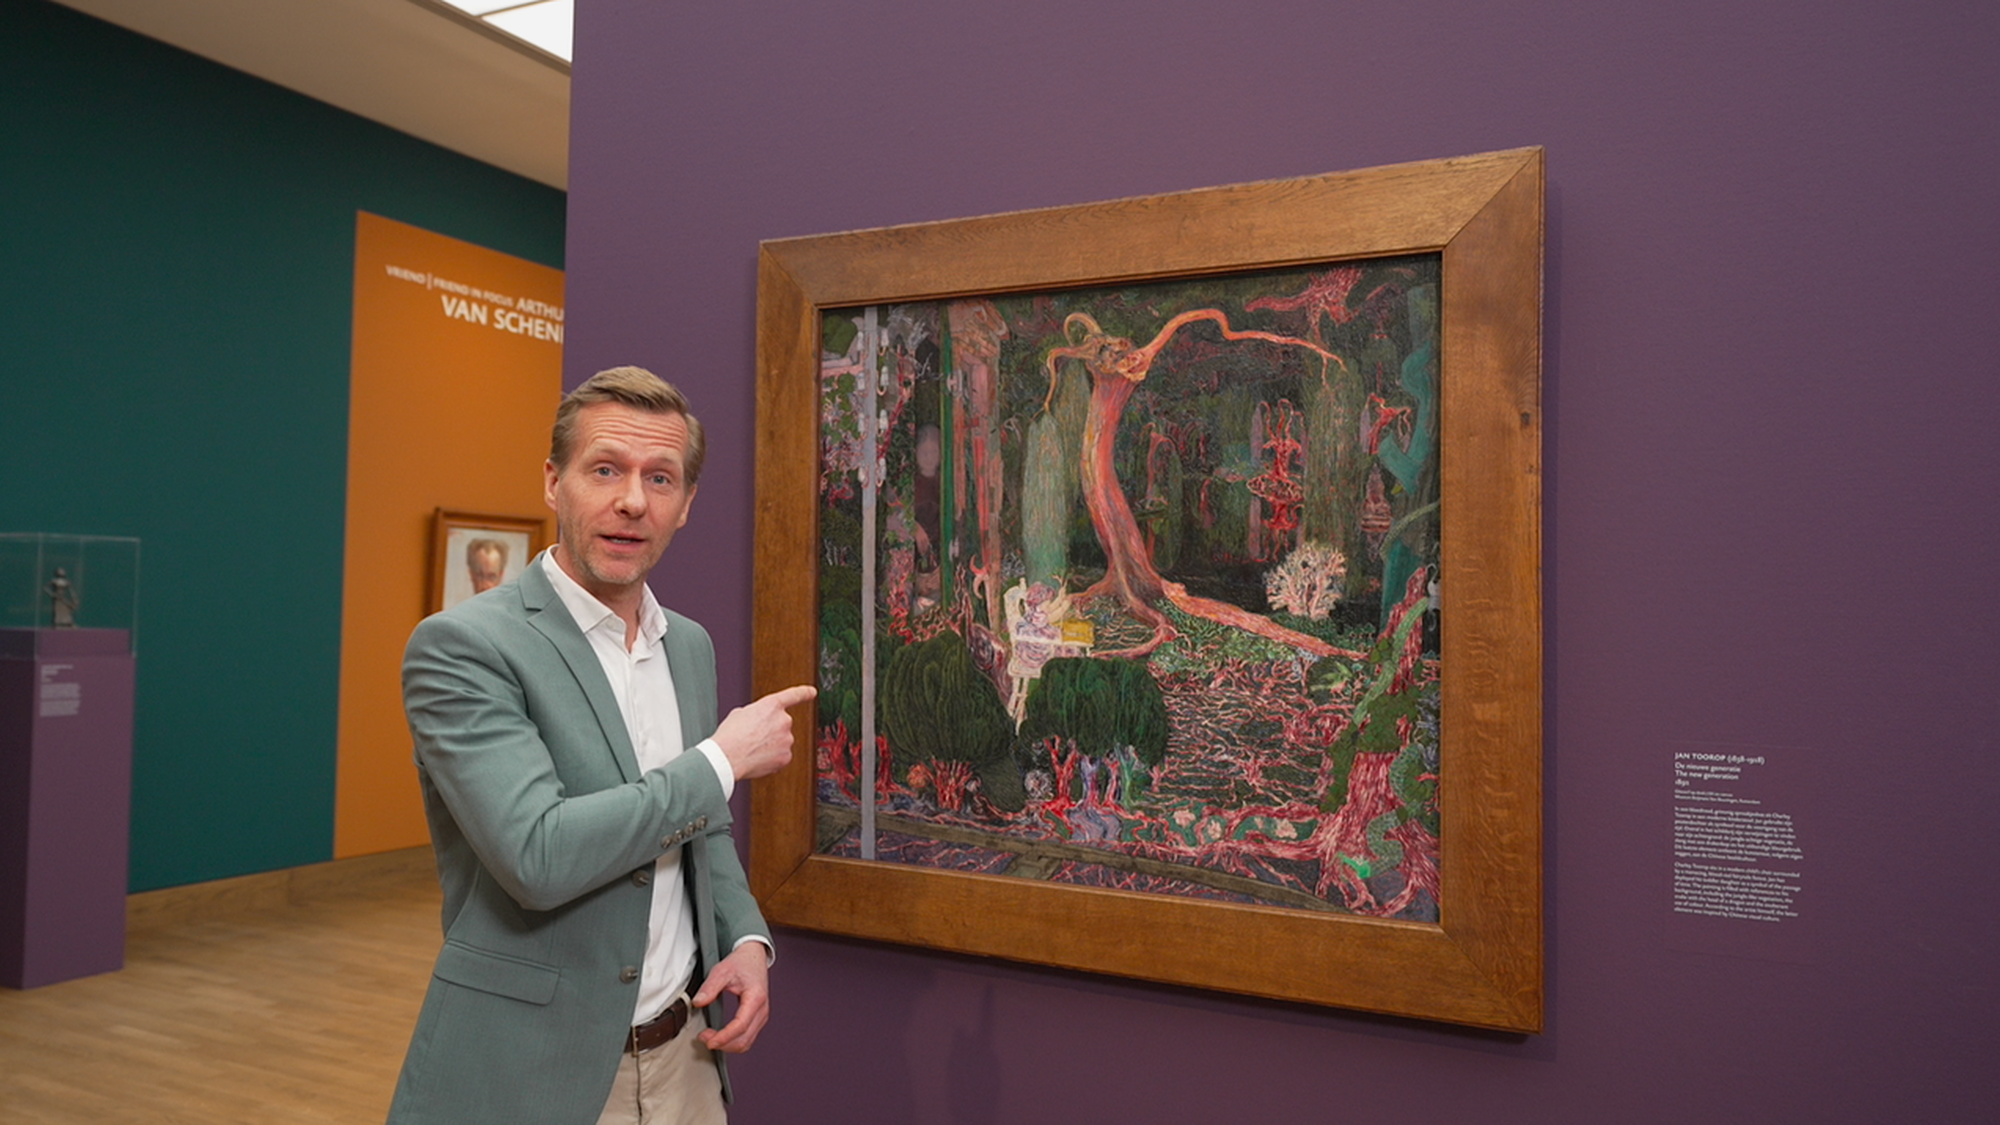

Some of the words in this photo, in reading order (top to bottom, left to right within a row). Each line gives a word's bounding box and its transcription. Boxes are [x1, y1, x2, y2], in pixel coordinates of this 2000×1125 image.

[385, 265, 425, 284] VRIEND
[434, 278, 469, 296] FRIEND
[471, 287, 481, 298] IN
[484, 291, 513, 306] FOCUS
[441, 295, 487, 325] VAN
[1675, 752, 1690, 760] JAN
[1692, 753, 1726, 762] TOOROP
[1711, 765, 1741, 774] generatie
[1704, 772, 1739, 782] generation
